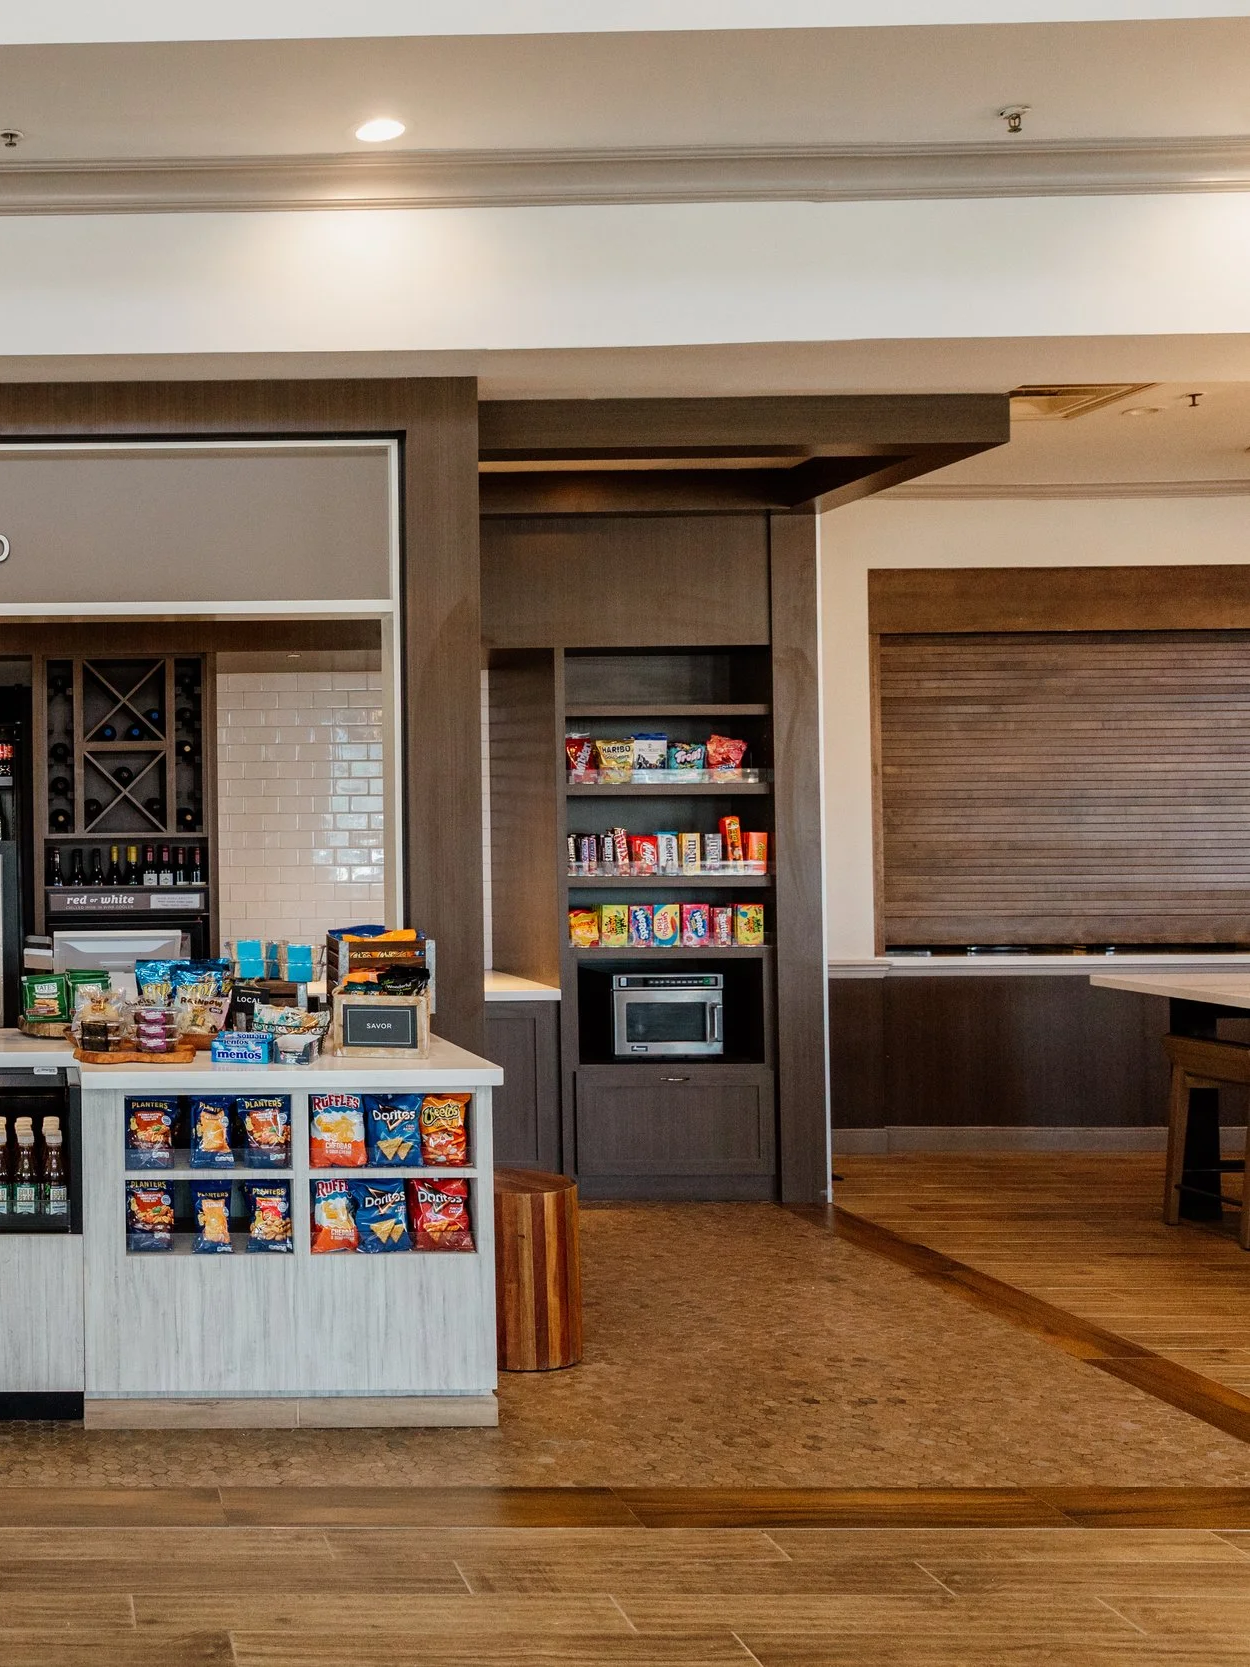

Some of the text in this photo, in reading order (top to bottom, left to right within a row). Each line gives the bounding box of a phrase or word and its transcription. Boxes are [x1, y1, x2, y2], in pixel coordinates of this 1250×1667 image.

[602, 745, 631, 753] HARIBO
[614, 834, 629, 862] TWIX
[67, 895, 87, 905] red
[100, 894, 135, 904] white
[635, 909, 650, 940] Nerds
[660, 911, 670, 937] Swedish
[694, 911, 705, 936] Nerds
[718, 913, 728, 942] Skittles
[180, 996, 223, 1008] RAINBOW
[236, 996, 262, 1004] LOCAL
[217, 1049, 262, 1060] mentos
[132, 1101, 169, 1109] PLANTERS
[245, 1099, 283, 1109] PLANTERS
[312, 1094, 360, 1110] RUFFLES
[372, 1109, 416, 1121] Doritos
[422, 1104, 460, 1126] Cheetos
[325, 1142, 352, 1150] CHEDDAR
[130, 1180, 167, 1188] PLANTERS
[252, 1187, 286, 1196] PLANTERS
[417, 1190, 463, 1203] Doritos
[364, 1191, 406, 1208] Doritos
